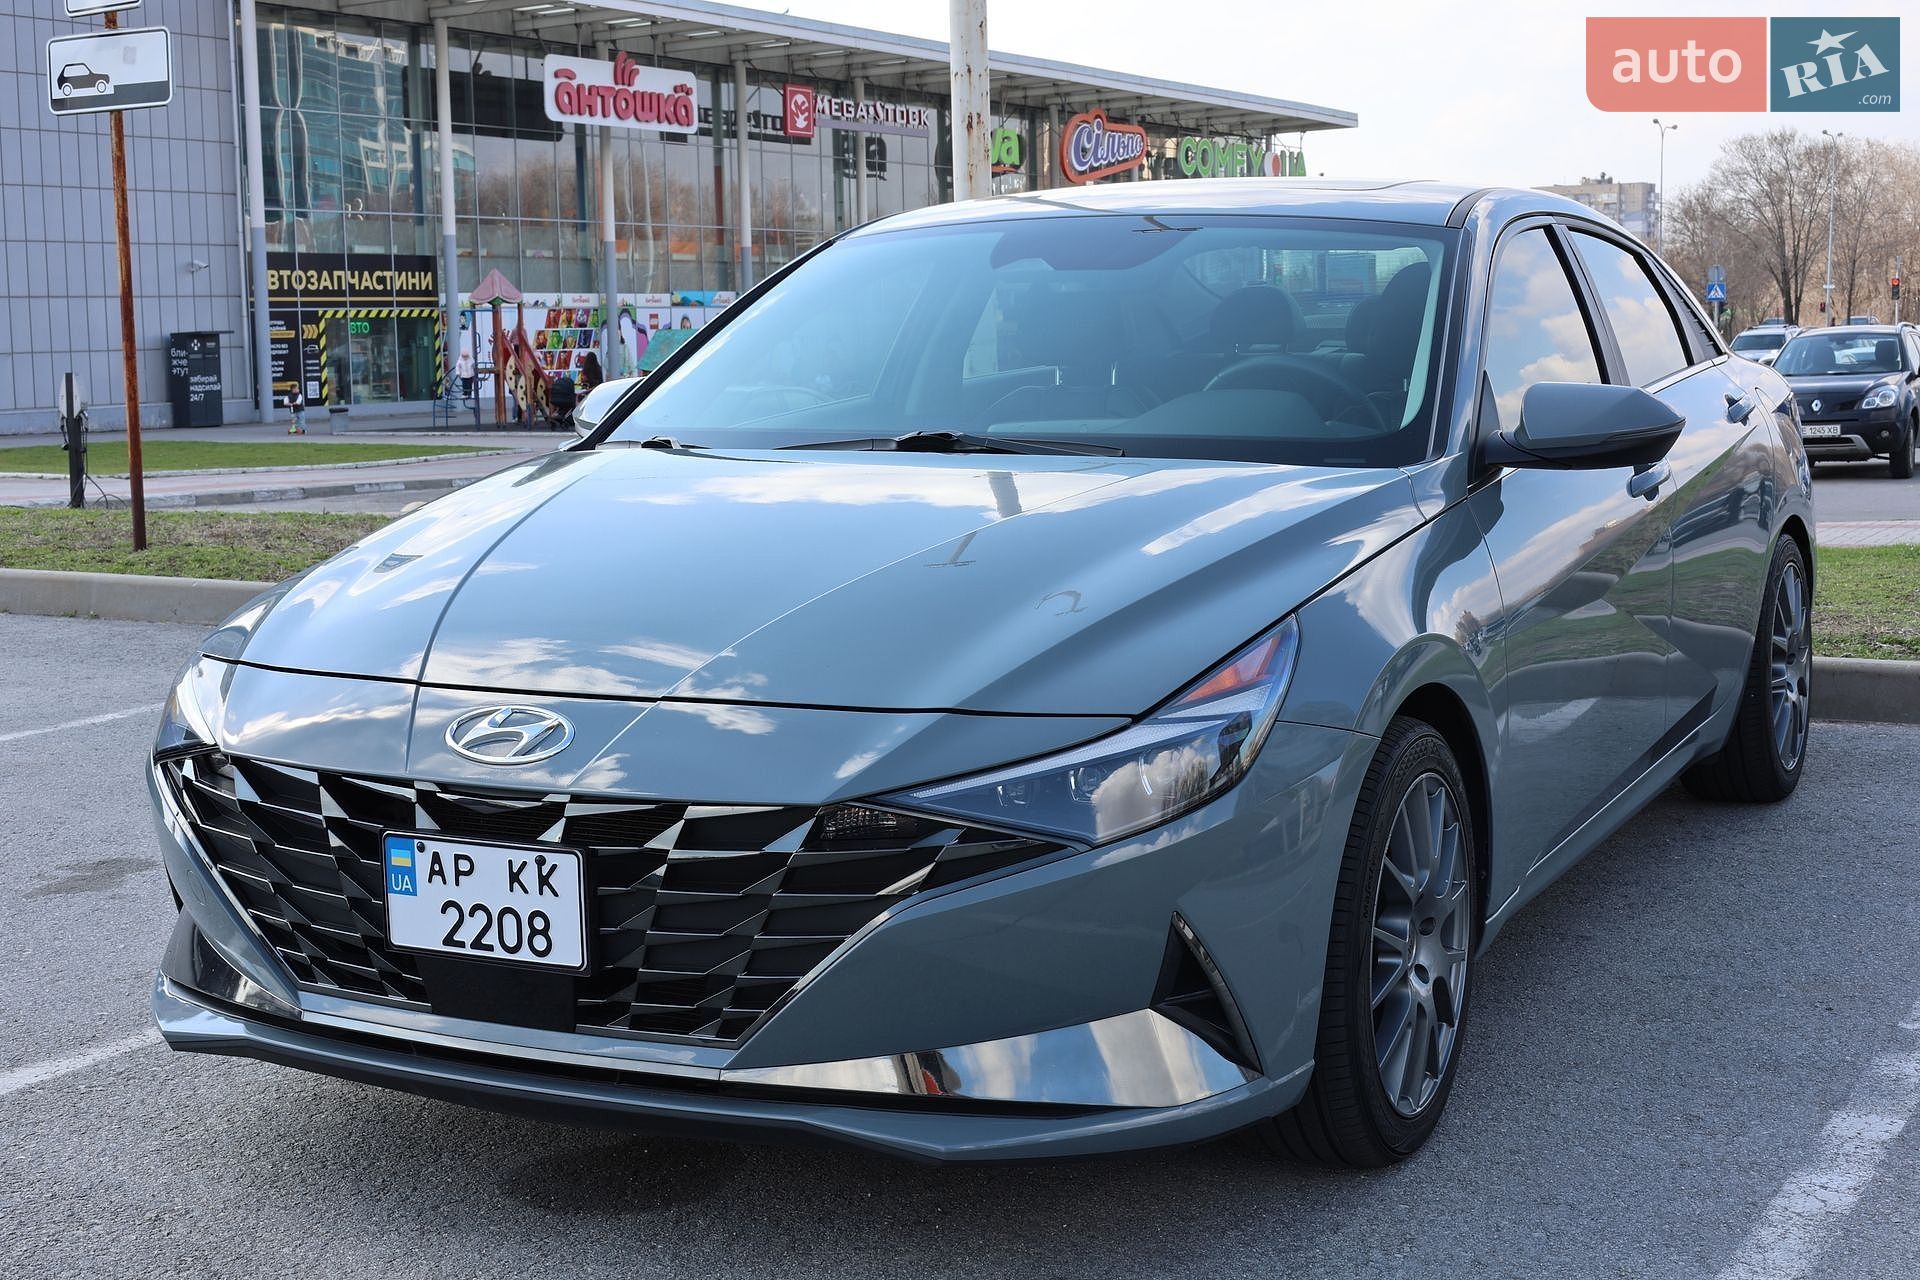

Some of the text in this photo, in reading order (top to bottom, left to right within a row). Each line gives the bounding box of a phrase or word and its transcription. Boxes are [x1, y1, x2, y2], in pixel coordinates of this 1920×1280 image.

[1071, 118, 1144, 172] Сільпо
[1180, 136, 1264, 176] COMFY
[266, 269, 433, 291] ВТОЗАПЧАСТИНИ
[190, 393, 204, 402] 24/7
[391, 873, 413, 892] UA
[427, 851, 559, 897] AP KK
[440, 899, 553, 958] 2208
